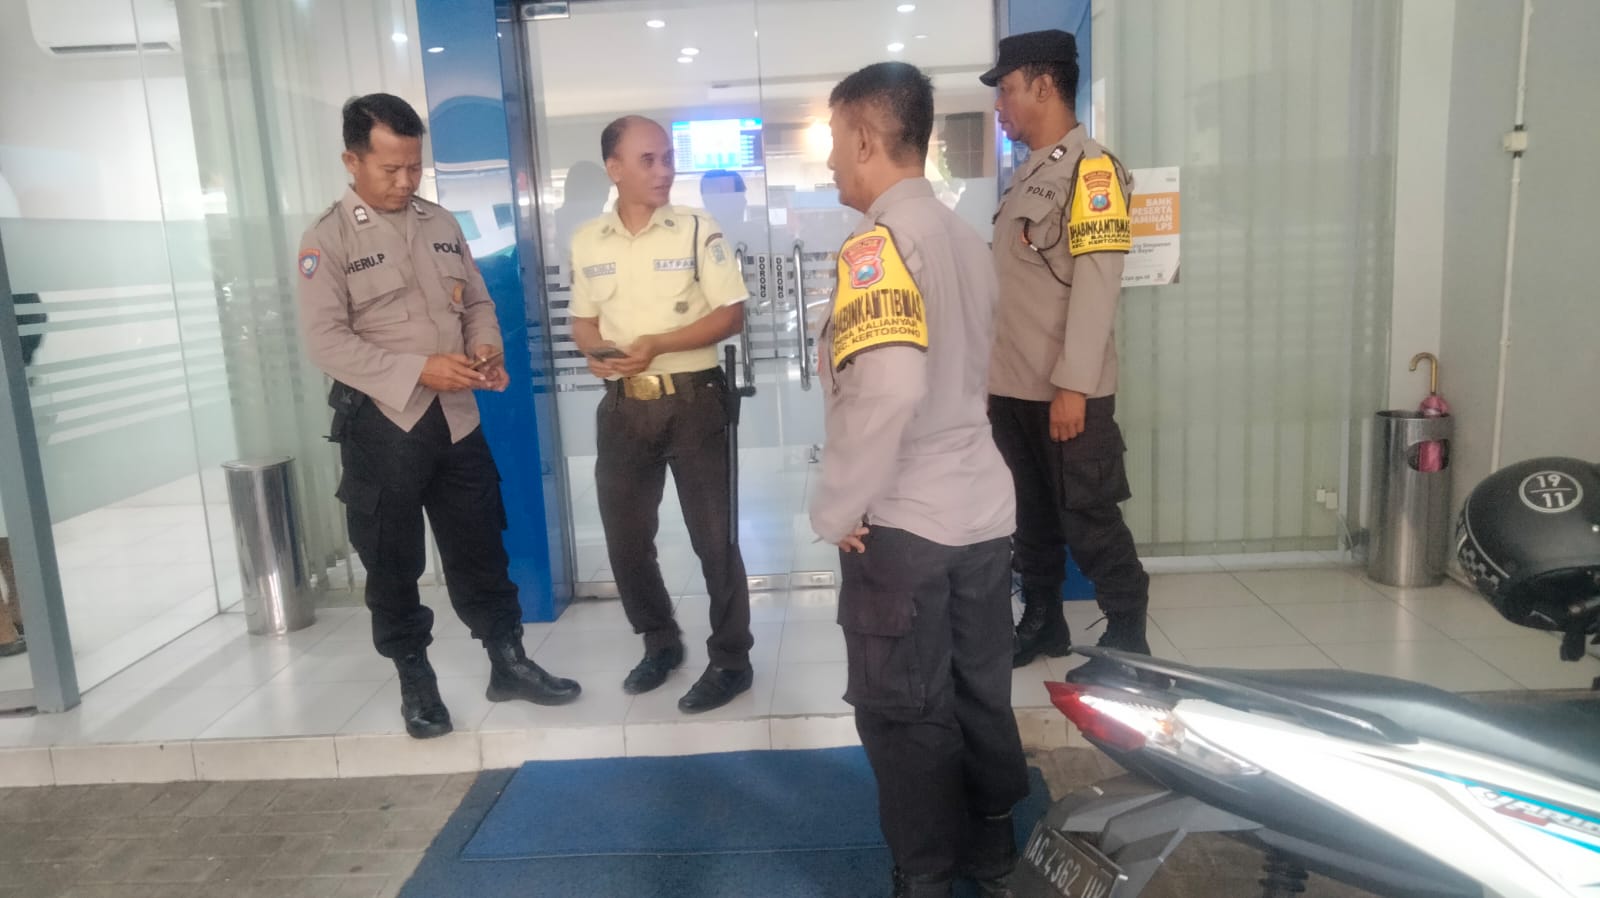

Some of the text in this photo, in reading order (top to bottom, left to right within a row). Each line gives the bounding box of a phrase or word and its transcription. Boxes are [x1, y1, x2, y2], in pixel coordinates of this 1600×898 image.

[1026, 185, 1056, 200] POLRI
[1145, 196, 1172, 208] BANK
[1131, 206, 1172, 216] PESERTA
[1155, 222, 1172, 231] LPS
[347, 253, 386, 274] HERU.P
[759, 256, 767, 298] DORONG
[775, 257, 785, 299] DORONG
[1536, 474, 1561, 488] 19
[1542, 492, 1565, 508] 11
[1027, 833, 1050, 866] AG
[1044, 848, 1081, 897] 4362
